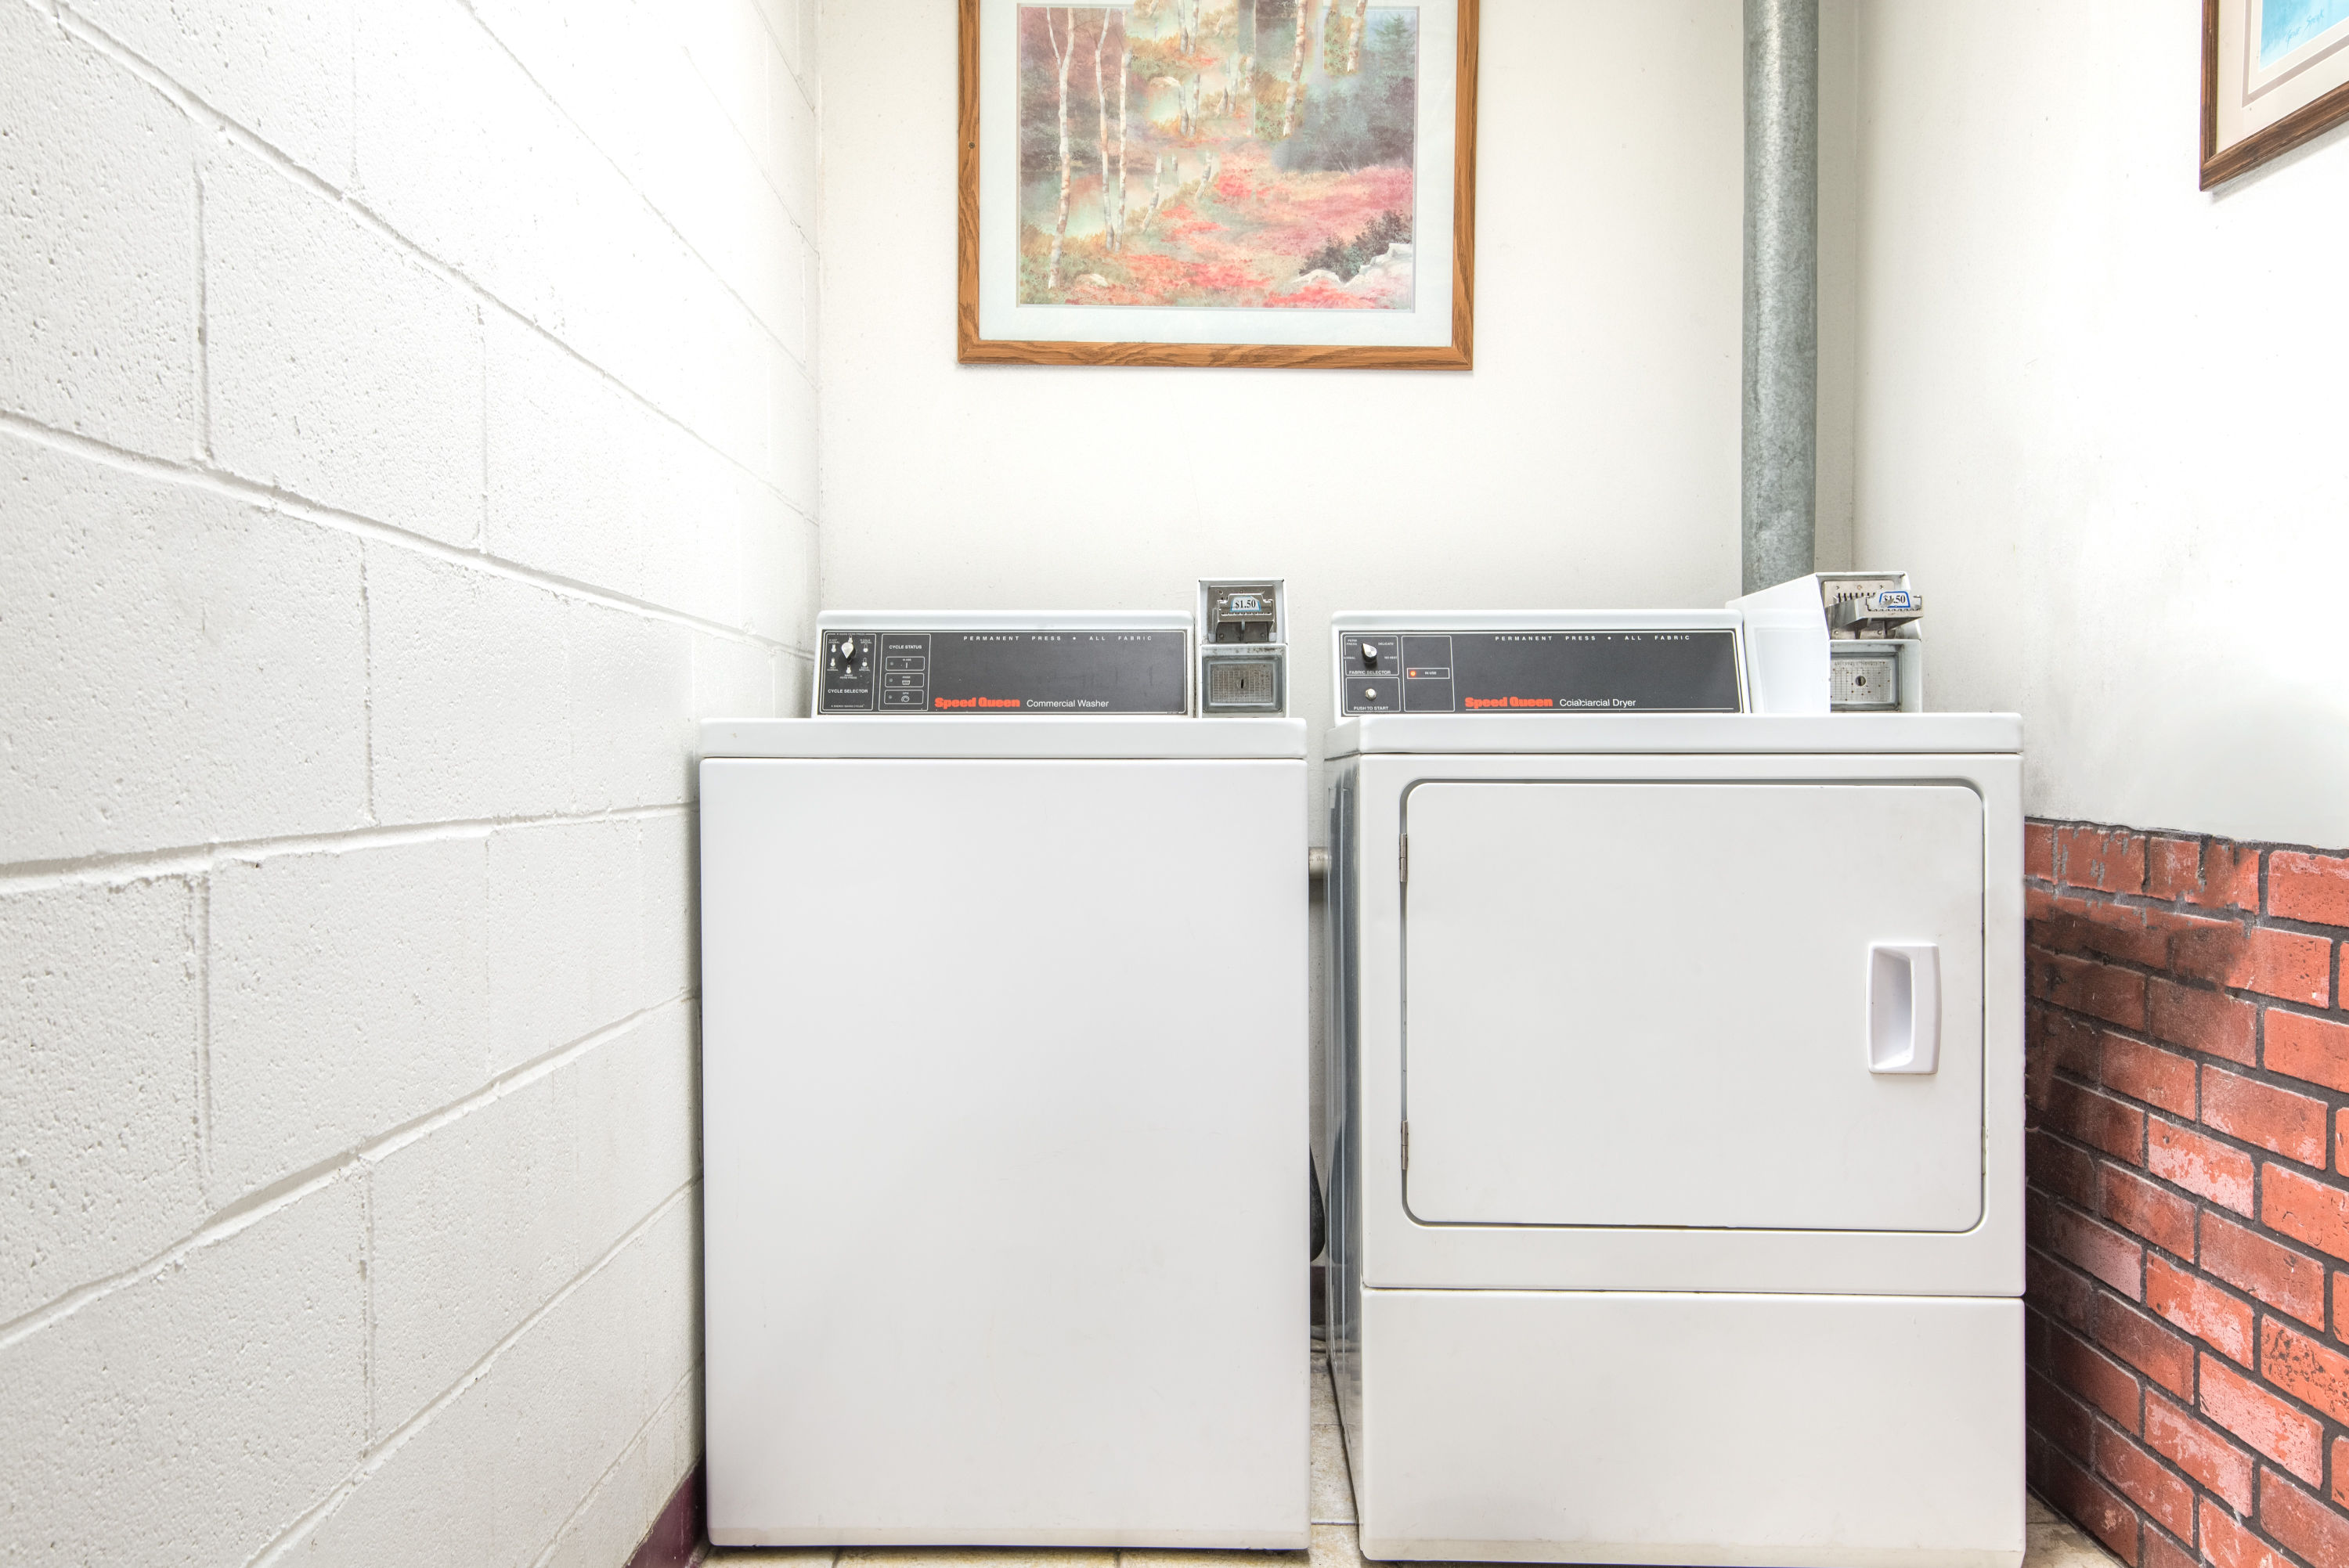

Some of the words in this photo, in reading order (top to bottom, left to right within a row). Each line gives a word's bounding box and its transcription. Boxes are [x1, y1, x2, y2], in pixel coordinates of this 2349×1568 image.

[1234, 600, 1256, 609] $1.50
[934, 696, 977, 709] Speed
[978, 696, 1020, 708] Queen
[1027, 699, 1076, 708] Commercial
[1077, 699, 1110, 708] Washer
[1464, 696, 1508, 709] Speed
[1509, 696, 1553, 708] Queen
[1612, 698, 1636, 708] Dryer
